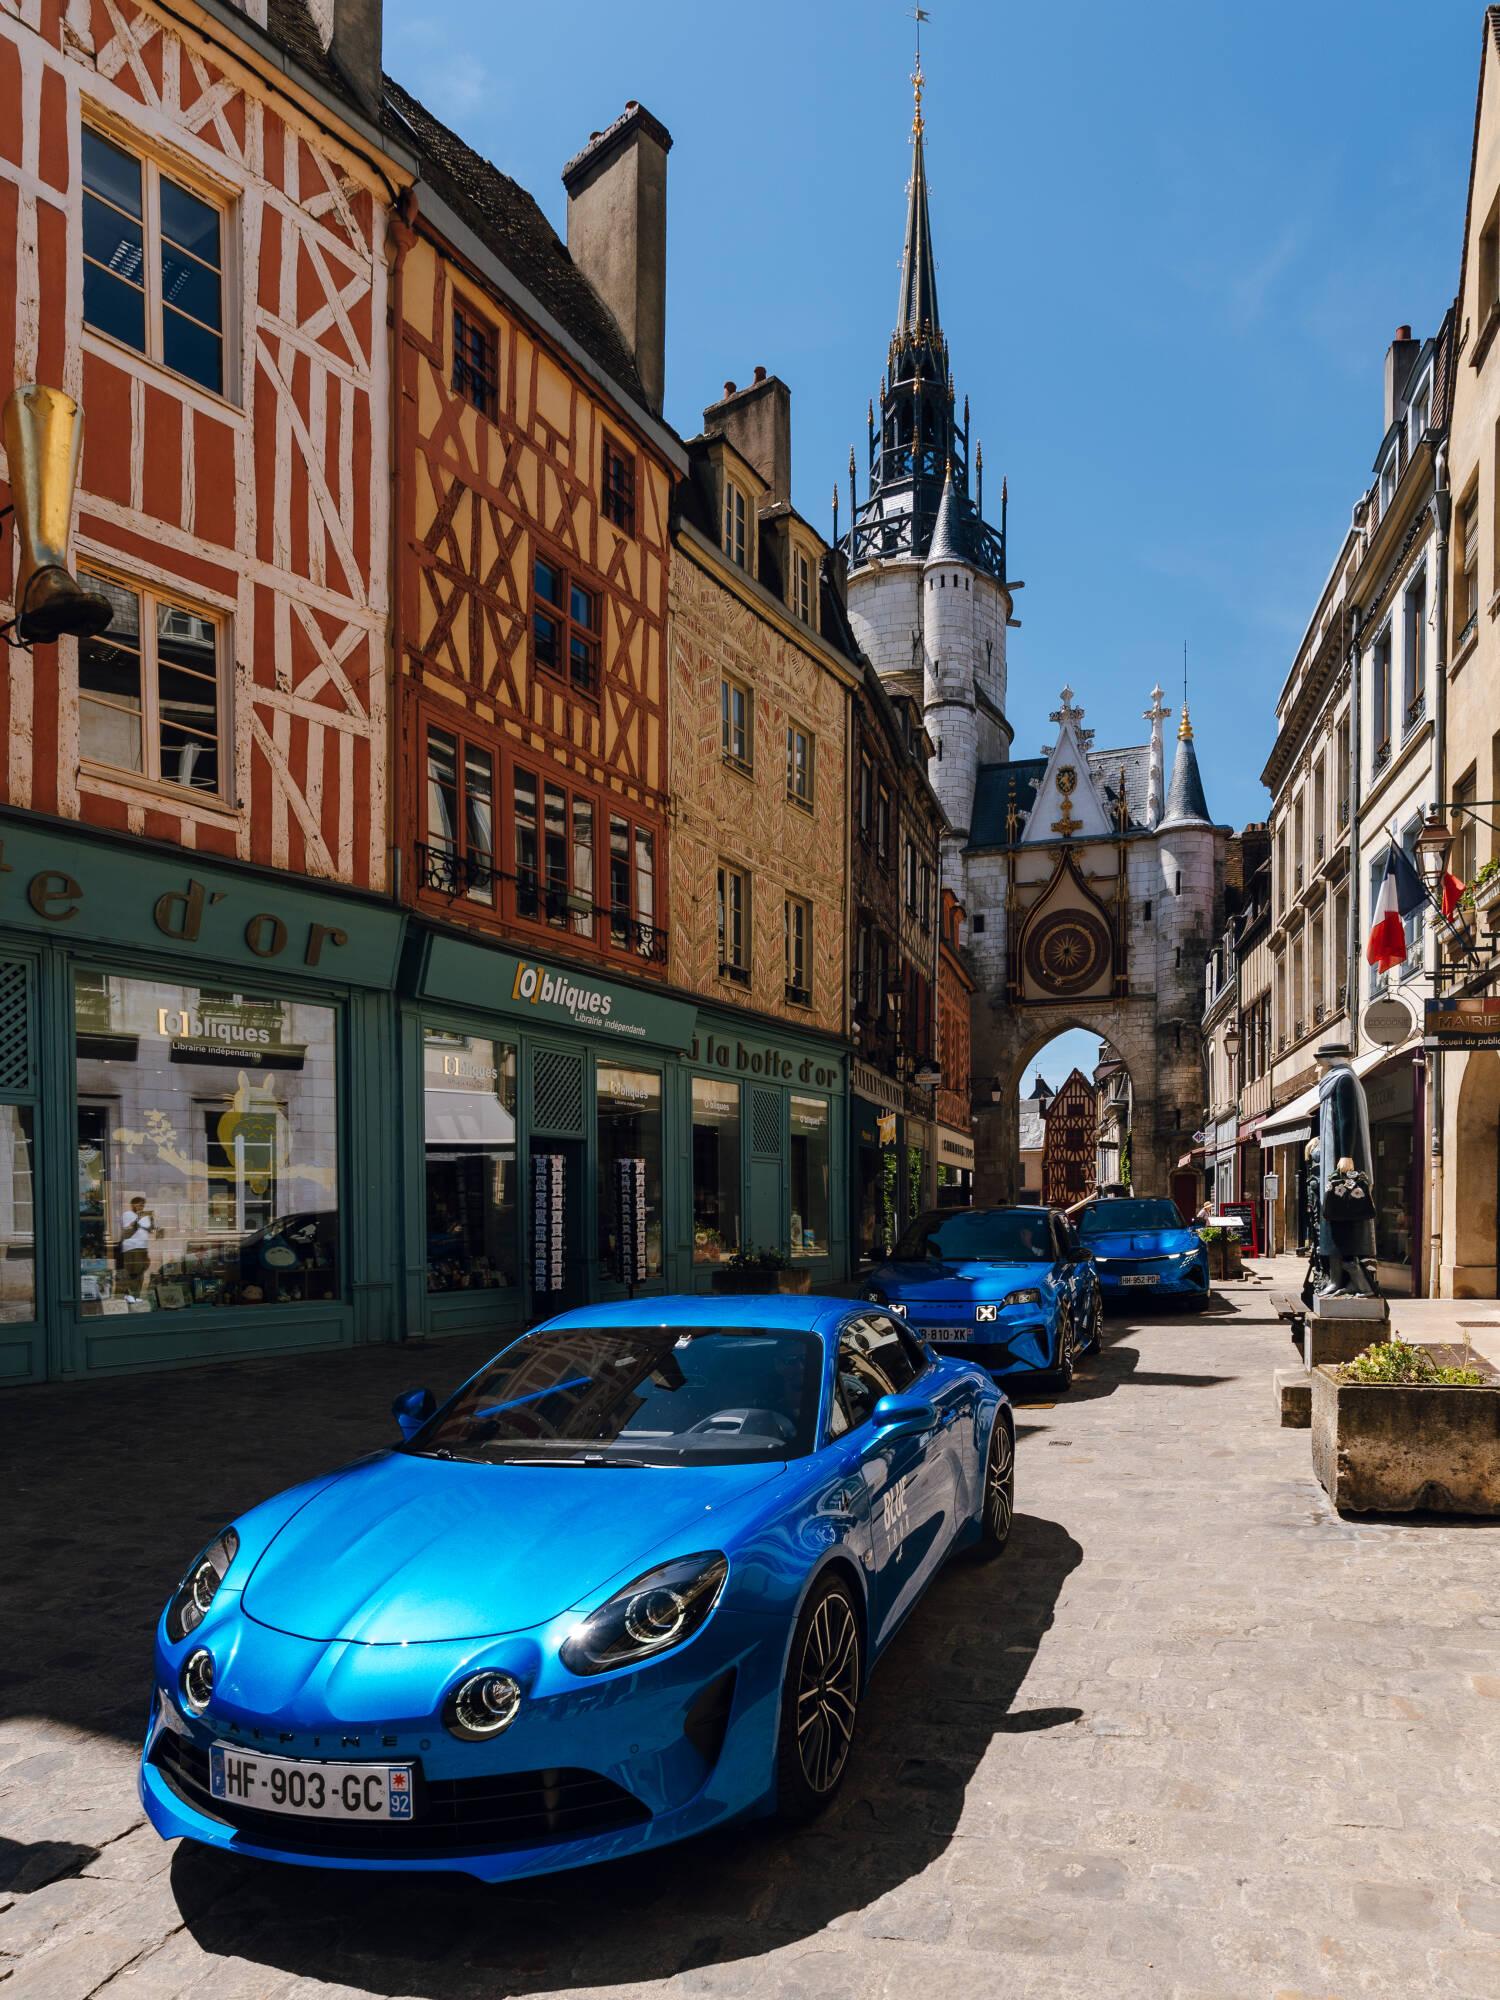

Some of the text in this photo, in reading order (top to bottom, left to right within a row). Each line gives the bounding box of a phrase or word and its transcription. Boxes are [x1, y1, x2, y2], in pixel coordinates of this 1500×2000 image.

[153, 878, 349, 966] d'or
[575, 1012, 646, 1036] Librairie indépendante
[1439, 1015, 1500, 1029] MAIRIE
[172, 1042, 261, 1060] Librairie indépendante
[1465, 1036, 1476, 1045] du
[707, 1035, 730, 1067] la
[737, 1041, 793, 1079] botte
[799, 1057, 839, 1088] d'or
[883, 1474, 908, 1531] BLUE
[230, 1721, 398, 1747] ALPINE
[227, 1758, 383, 1812] HF-903-GC
[391, 1796, 410, 1813] 92
